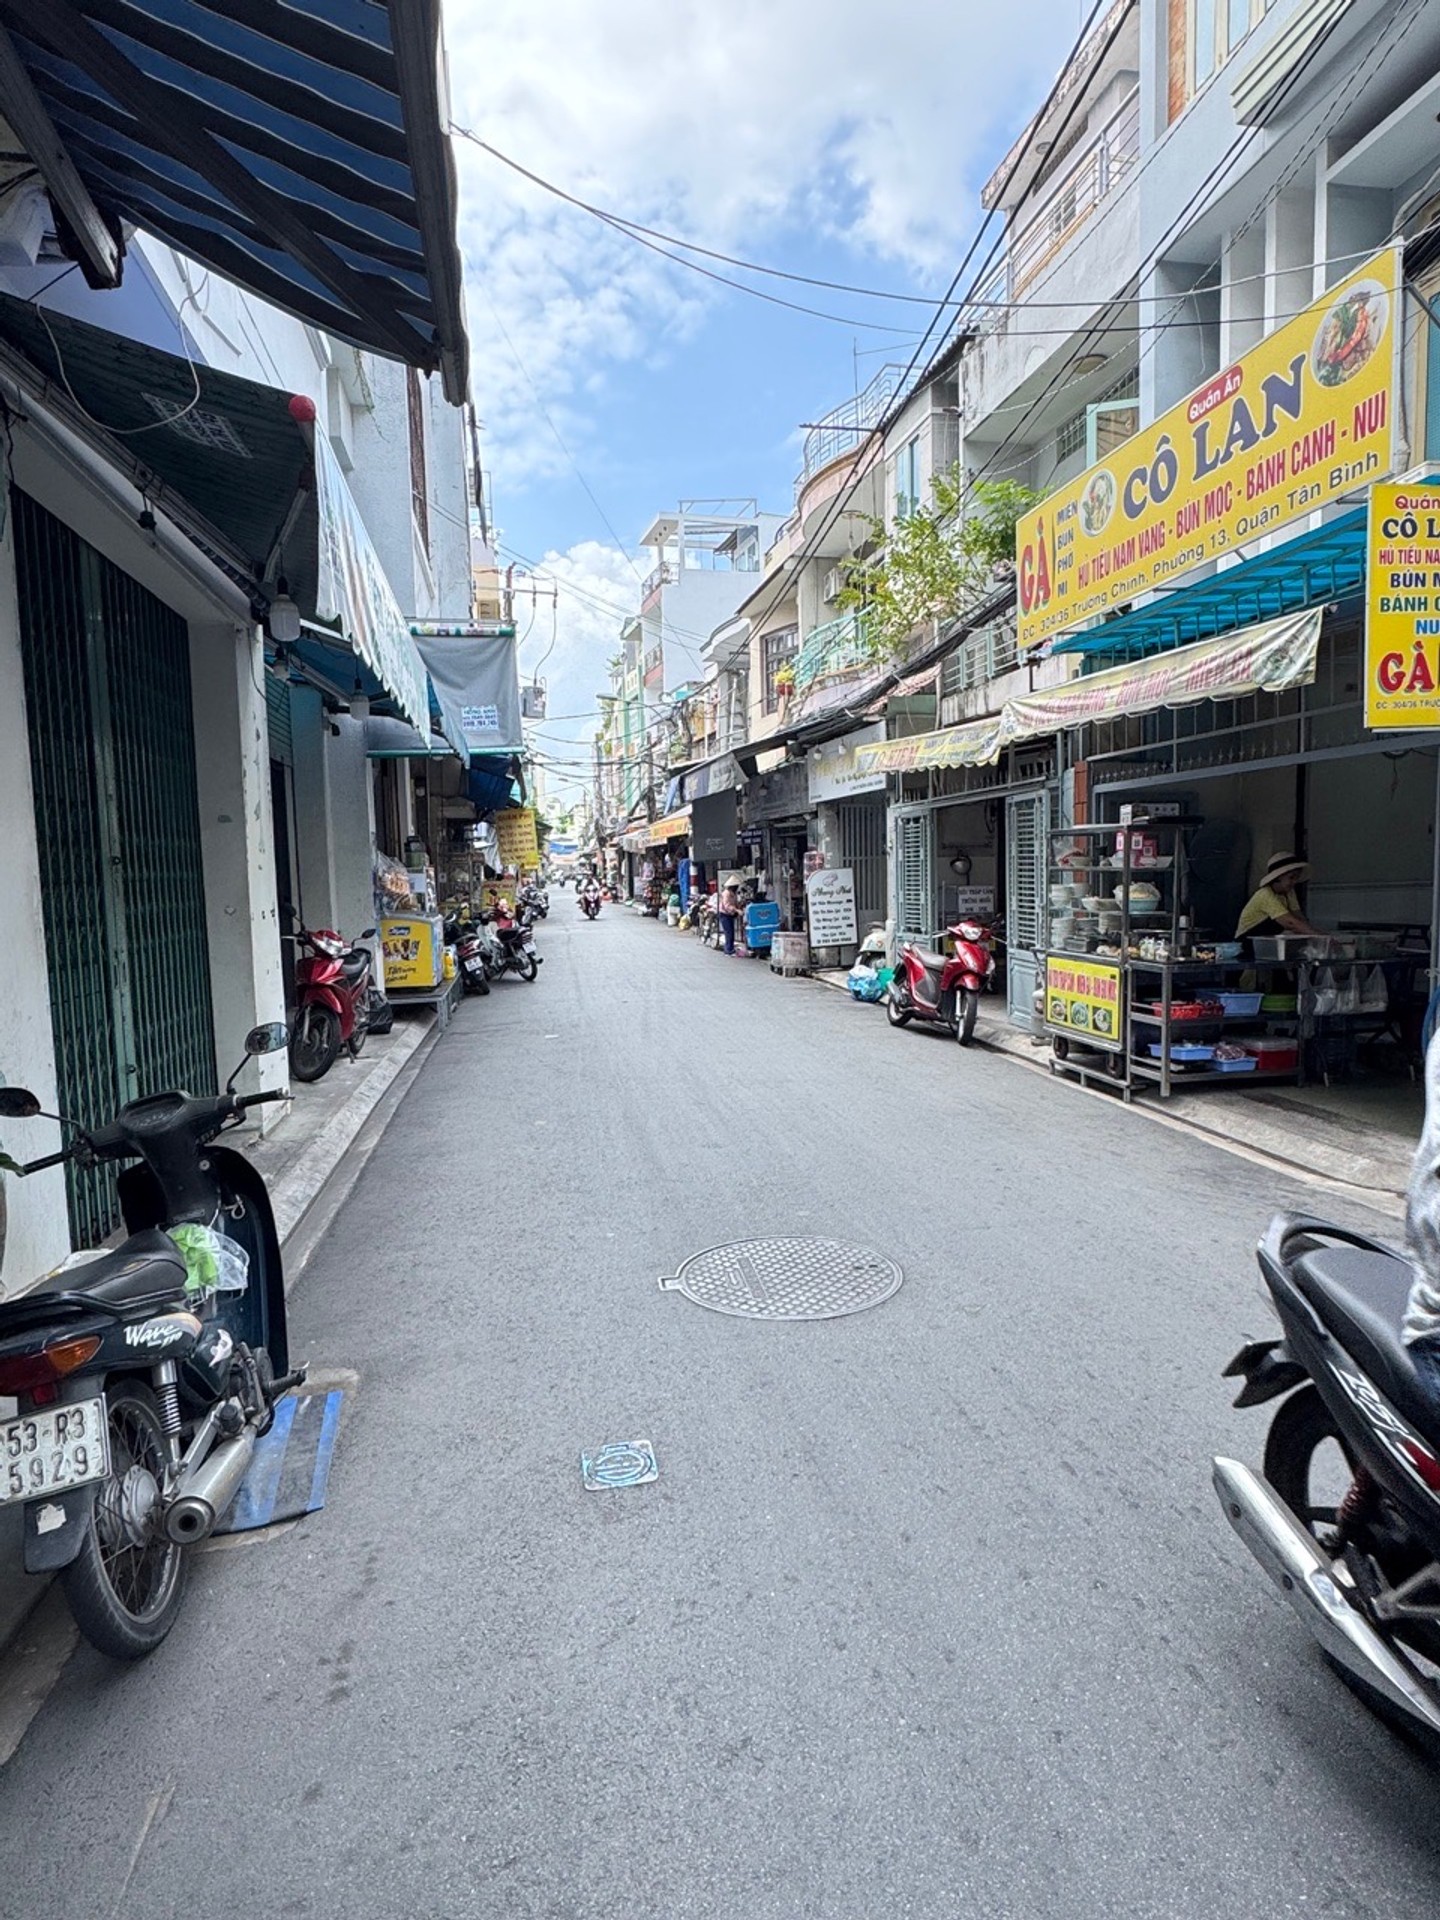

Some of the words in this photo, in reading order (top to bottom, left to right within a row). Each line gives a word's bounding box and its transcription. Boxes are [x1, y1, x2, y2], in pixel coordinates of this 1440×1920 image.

[1189, 388, 1220, 420] Quán
[1223, 374, 1242, 397] Ăn
[1123, 435, 1178, 519] CÔ
[1192, 354, 1306, 481] LAN
[1113, 537, 1135, 573] NAM
[1138, 520, 1166, 560] VANG
[1176, 498, 1200, 539] BÚN
[1204, 480, 1233, 524] MỌC
[1246, 449, 1286, 501] BÁNH
[1291, 419, 1336, 476] CANH
[1353, 390, 1386, 442] NUI
[1236, 505, 1280, 536] Quận
[1287, 481, 1322, 510] Tân
[1329, 452, 1379, 490] Bình
[1394, 494, 1440, 511] Quán
[1382, 511, 1419, 539] CÔ
[1378, 544, 1394, 565] HỦ
[1398, 544, 1422, 565] TIẾU
[1390, 569, 1426, 589] BÚN
[1380, 593, 1429, 613] BÁNH
[1377, 640, 1436, 695] GÀ
[123, 1321, 181, 1347] Wave
[7, 1409, 86, 1458] 53-R3
[8, 1445, 88, 1494] 5929
